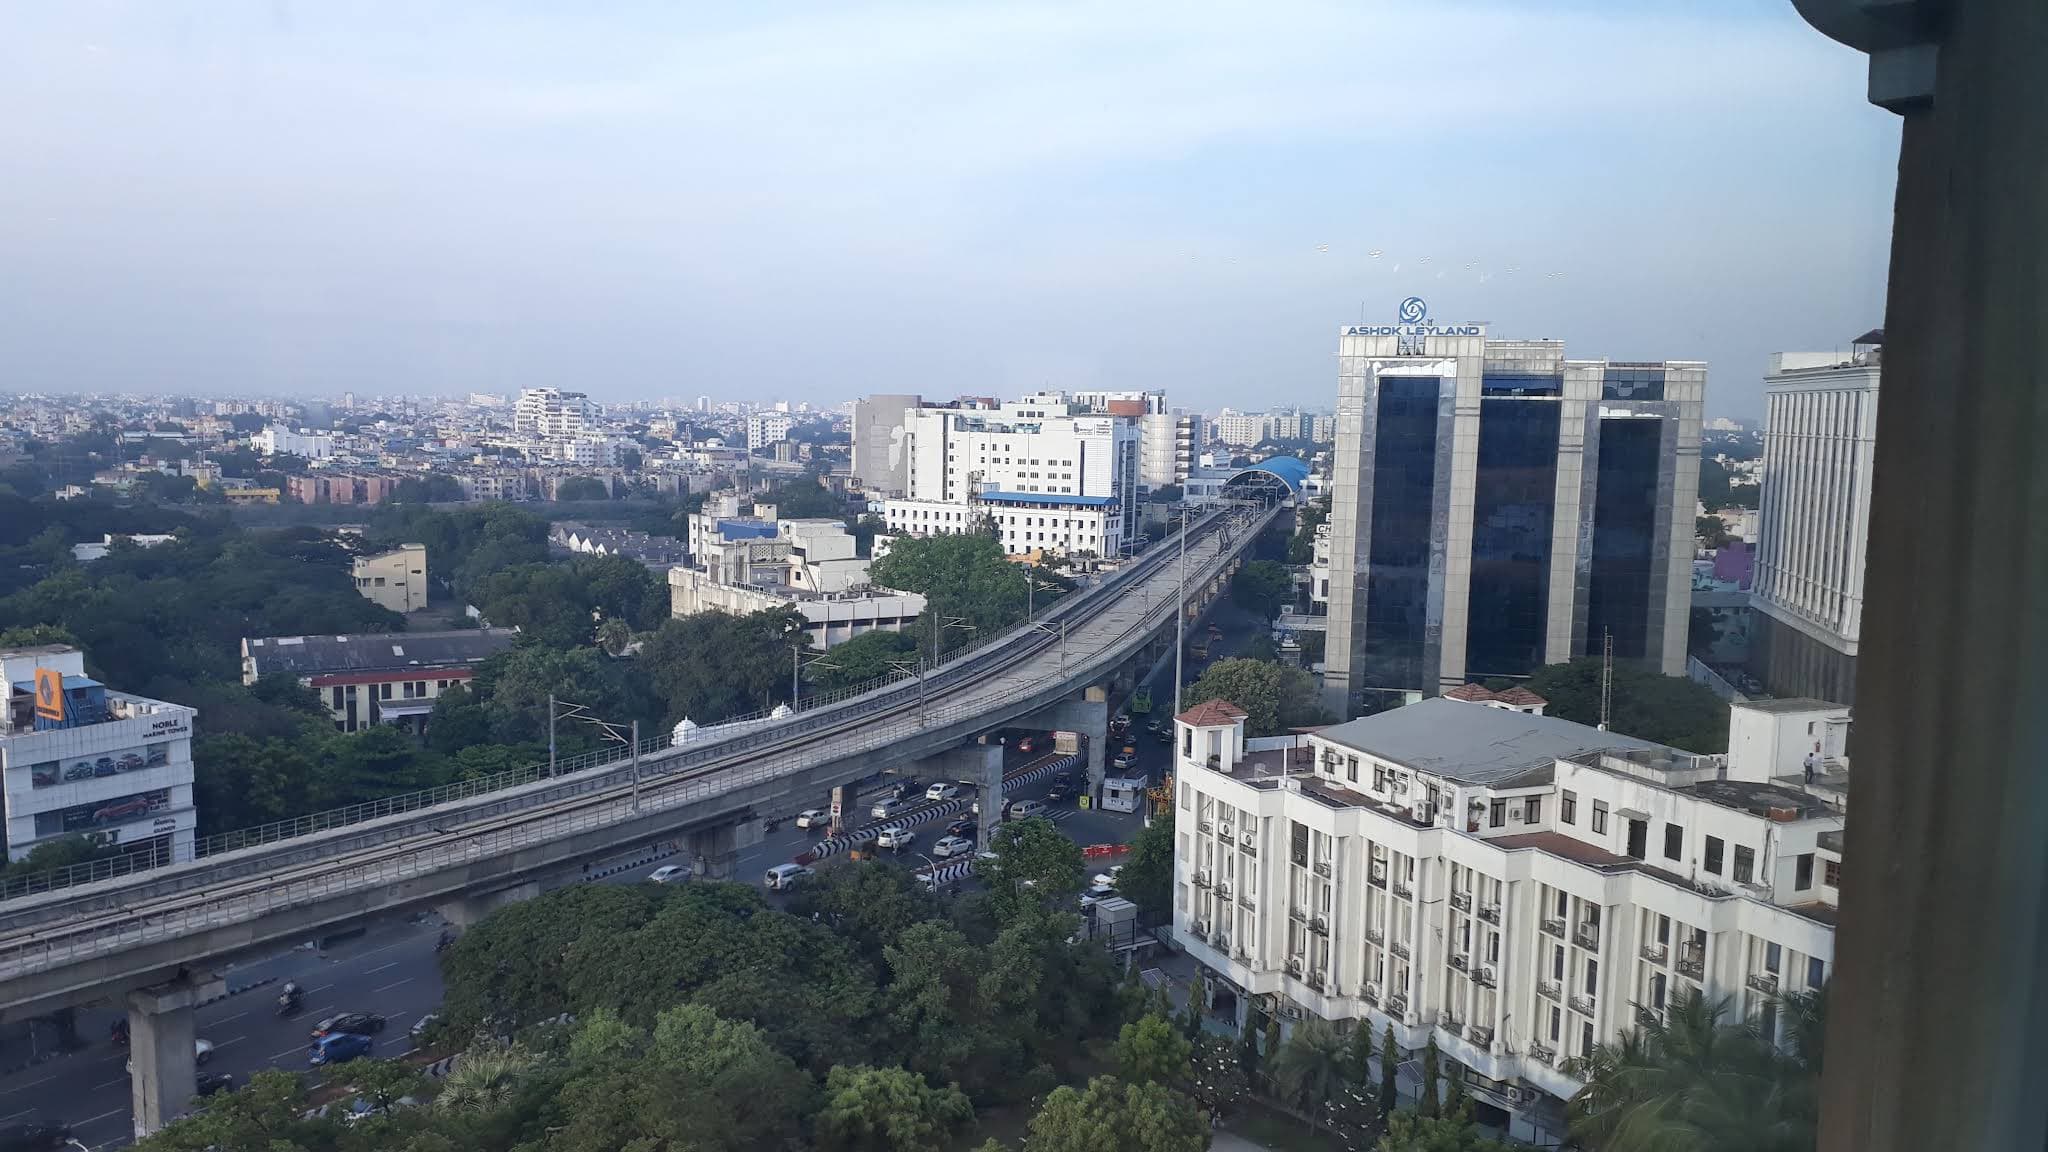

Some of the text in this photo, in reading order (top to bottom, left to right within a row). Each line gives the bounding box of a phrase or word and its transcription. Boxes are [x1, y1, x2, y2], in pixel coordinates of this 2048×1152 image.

[1347, 326, 1480, 336] ASHOK LEYLAND
[152, 719, 178, 729] NOBLE
